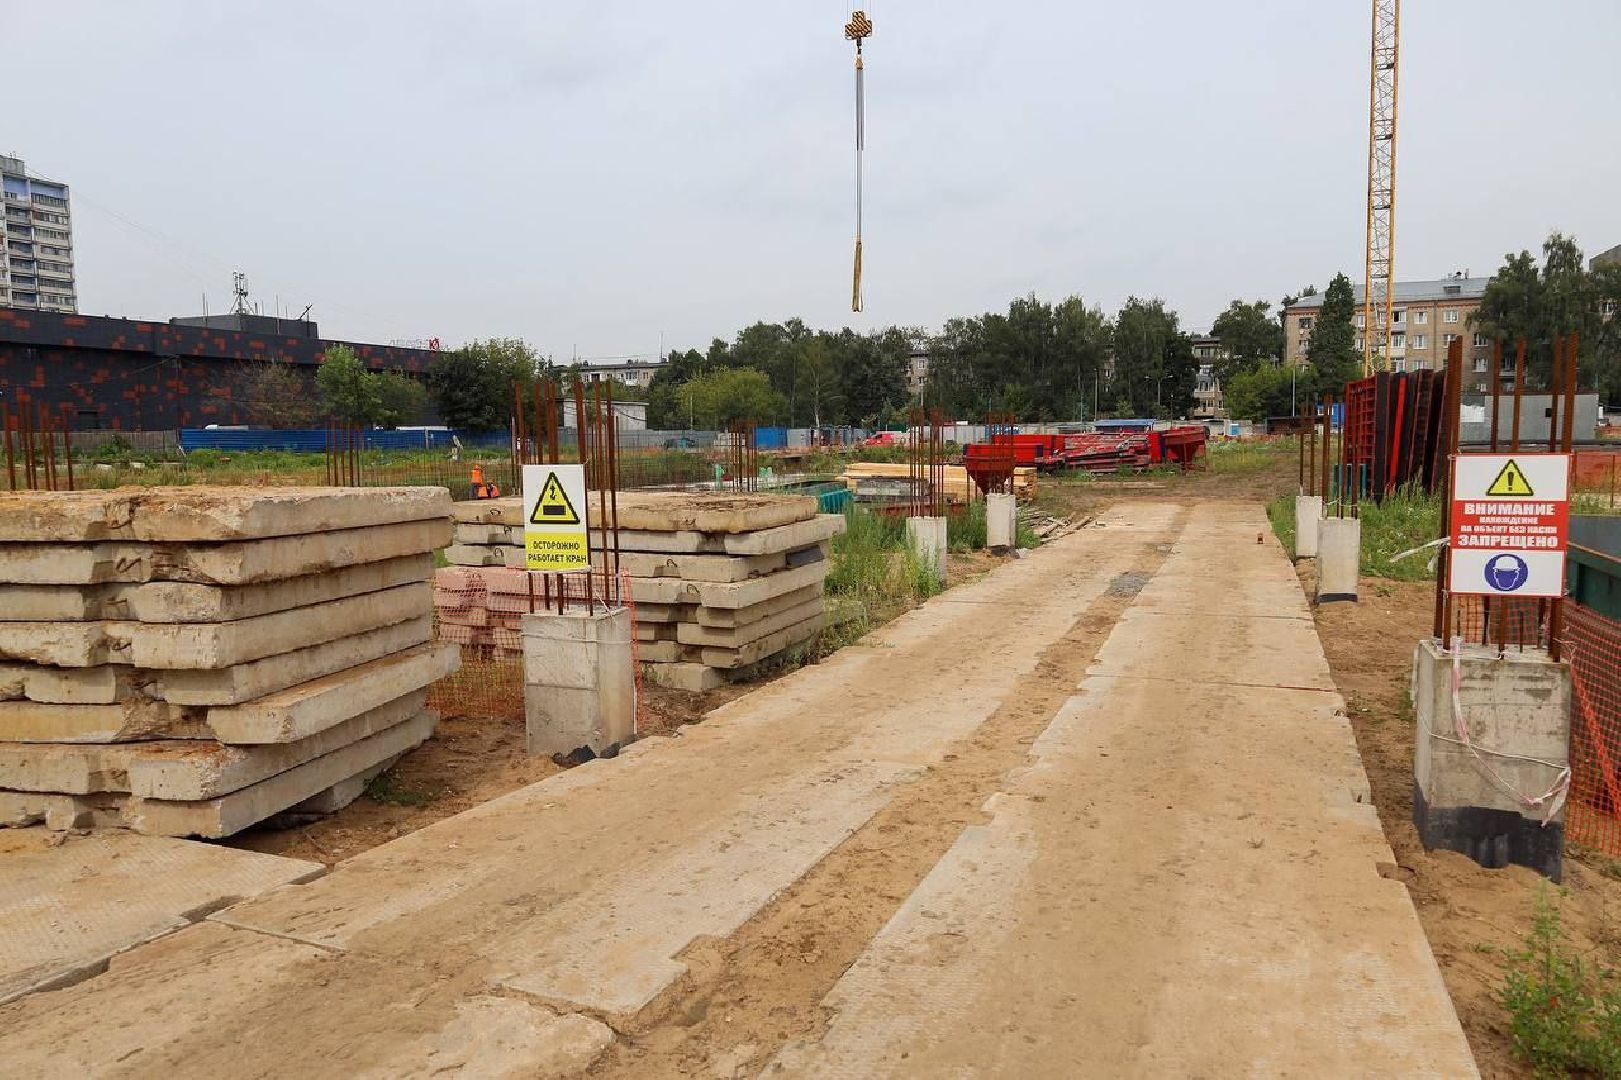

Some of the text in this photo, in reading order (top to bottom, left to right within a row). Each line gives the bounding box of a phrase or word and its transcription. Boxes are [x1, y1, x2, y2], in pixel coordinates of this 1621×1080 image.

[1464, 502, 1556, 515] ВНИМАНИЕ
[533, 540, 580, 550] ОСТОРОЖНО
[1457, 534, 1558, 549] ЗАПРЕЩЕНО
[528, 553, 587, 564] РАБОТАЕТ КРАН
